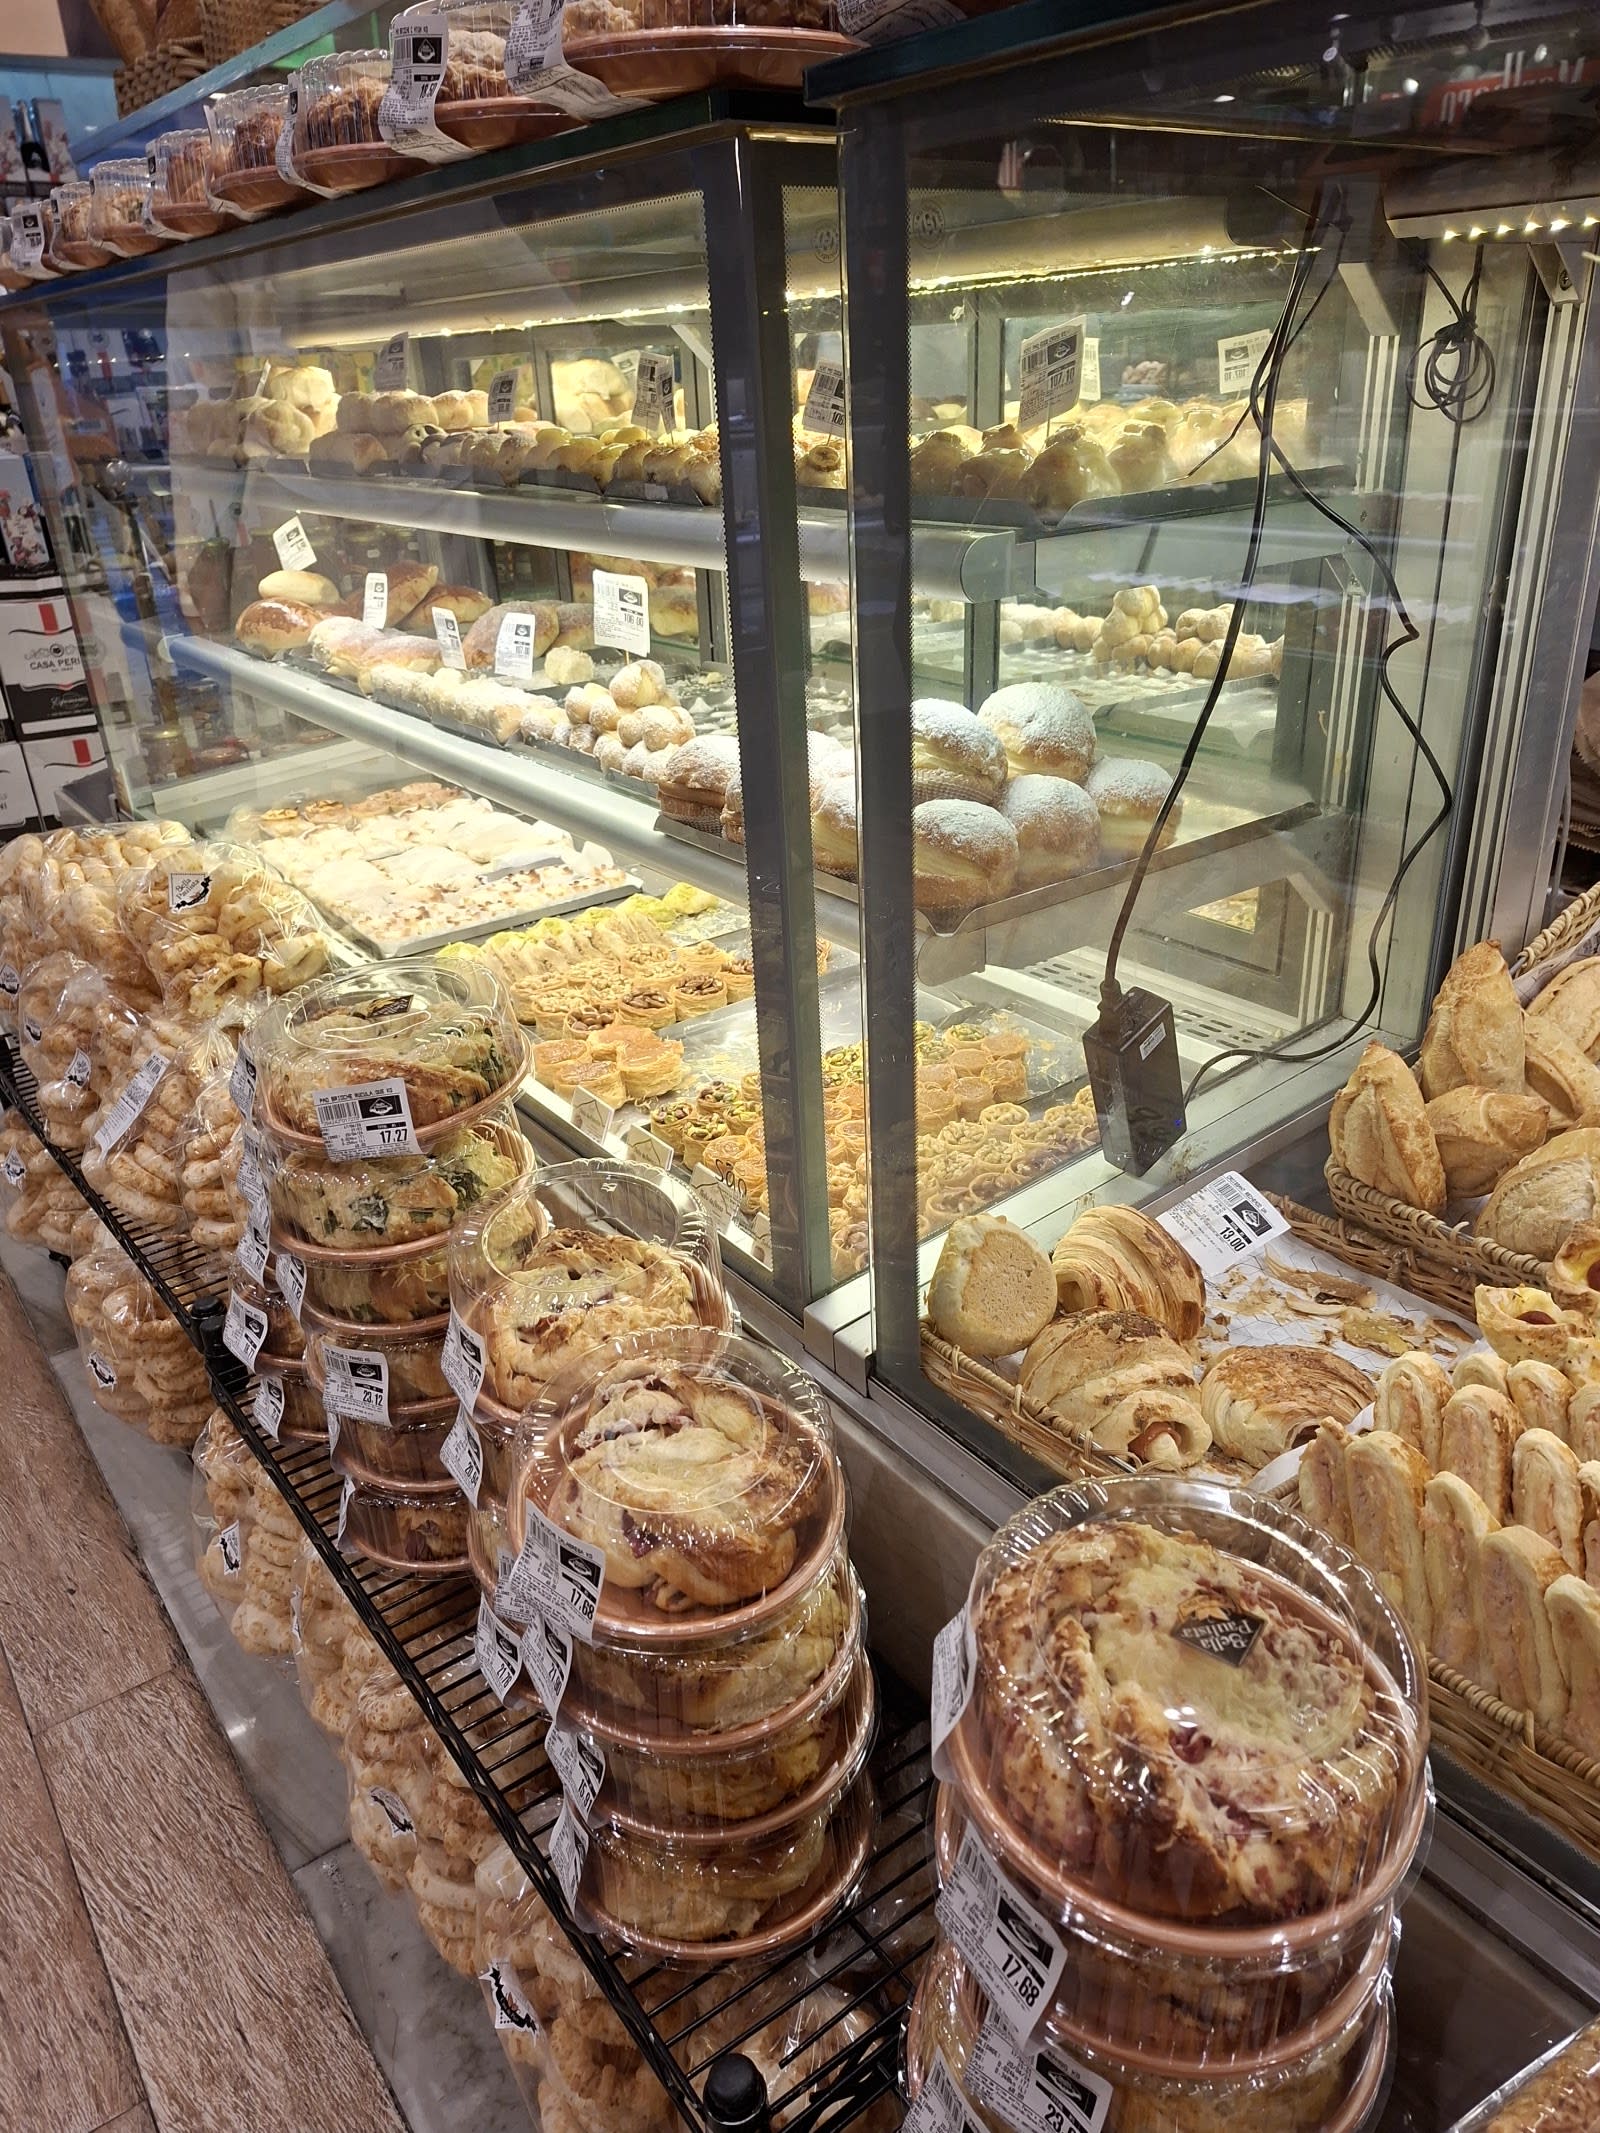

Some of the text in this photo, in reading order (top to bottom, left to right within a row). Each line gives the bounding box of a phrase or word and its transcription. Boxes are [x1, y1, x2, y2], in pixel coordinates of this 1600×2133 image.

[30, 661, 56, 670] CASA
[1182, 1620, 1253, 1639] Paulista
[1199, 1632, 1247, 1653] Bella
[1001, 1953, 1040, 2007] 17,68
